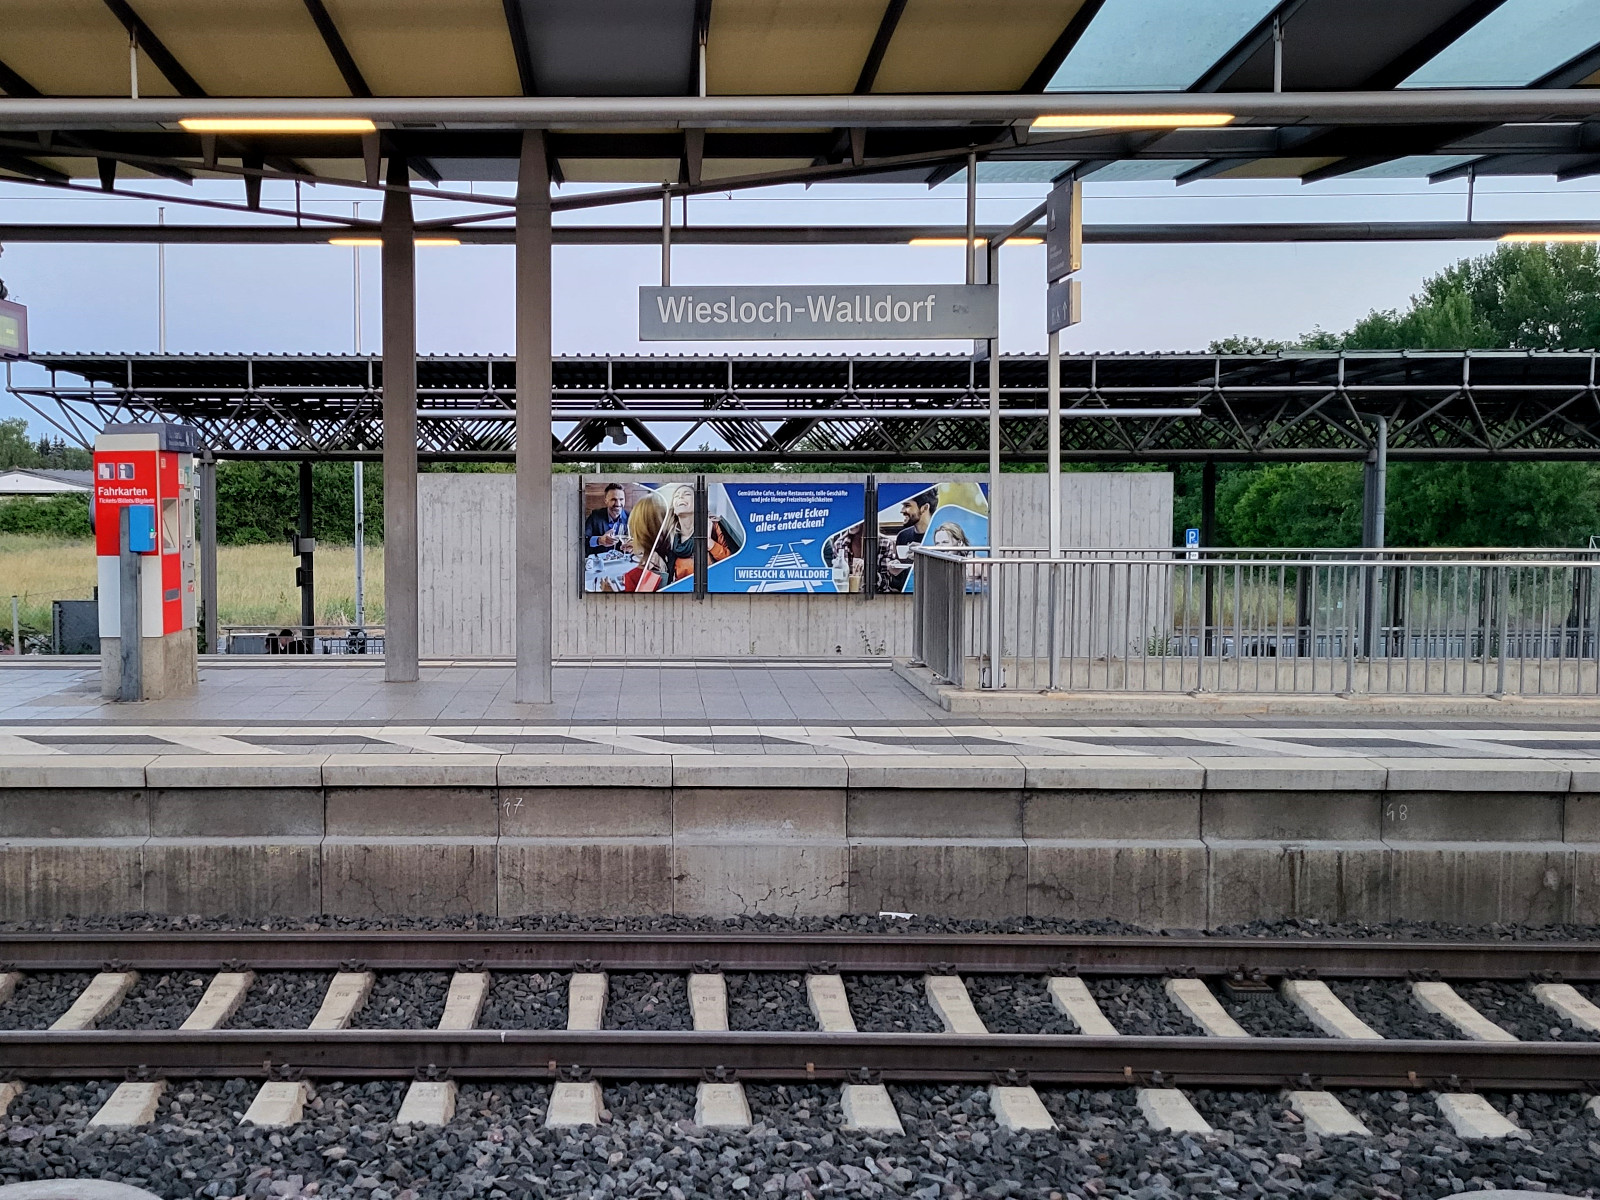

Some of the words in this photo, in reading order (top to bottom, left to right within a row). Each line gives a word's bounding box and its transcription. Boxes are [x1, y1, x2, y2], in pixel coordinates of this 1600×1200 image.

[656, 294, 936, 323] Wiesloch-Walldorf
[98, 487, 147, 496] Fahrkarten
[750, 513, 764, 523] Um
[765, 511, 782, 522] ein,
[783, 508, 804, 520] zwei
[805, 508, 829, 517] Ecken
[755, 522, 776, 532] alles
[778, 517, 825, 531] entdecken!
[1189, 531, 1196, 544] P
[738, 570, 777, 579] WIESLOCH
[779, 570, 786, 579] &
[787, 570, 829, 579] WALLDORF
